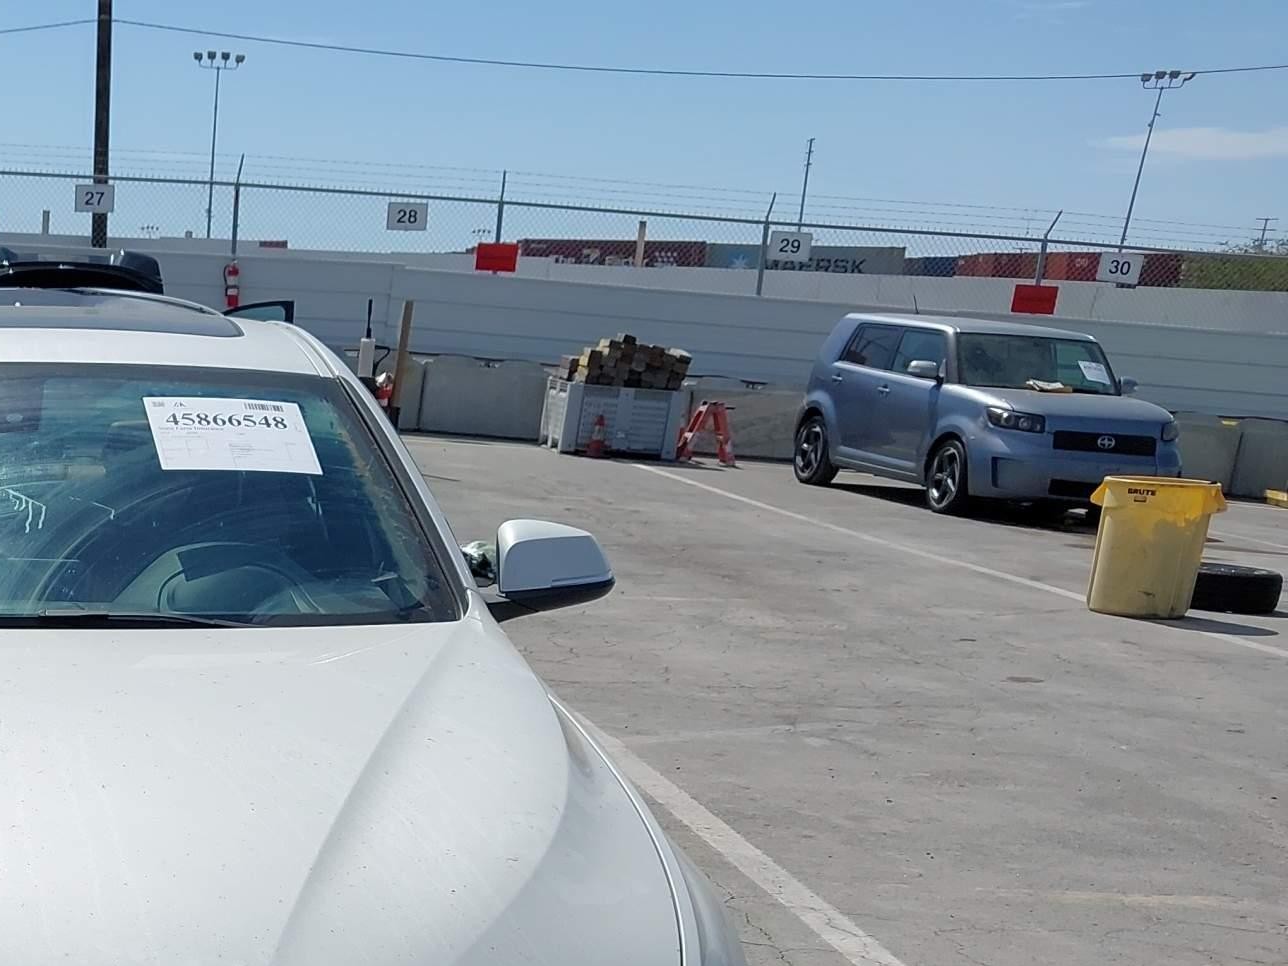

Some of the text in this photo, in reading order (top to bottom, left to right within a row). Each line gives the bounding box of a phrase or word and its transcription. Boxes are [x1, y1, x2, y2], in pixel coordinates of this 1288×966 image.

[84, 191, 105, 206] 27
[396, 209, 418, 224] 28
[779, 238, 801, 254] 29
[1108, 259, 1131, 276] 30
[165, 413, 288, 430] 45866548
